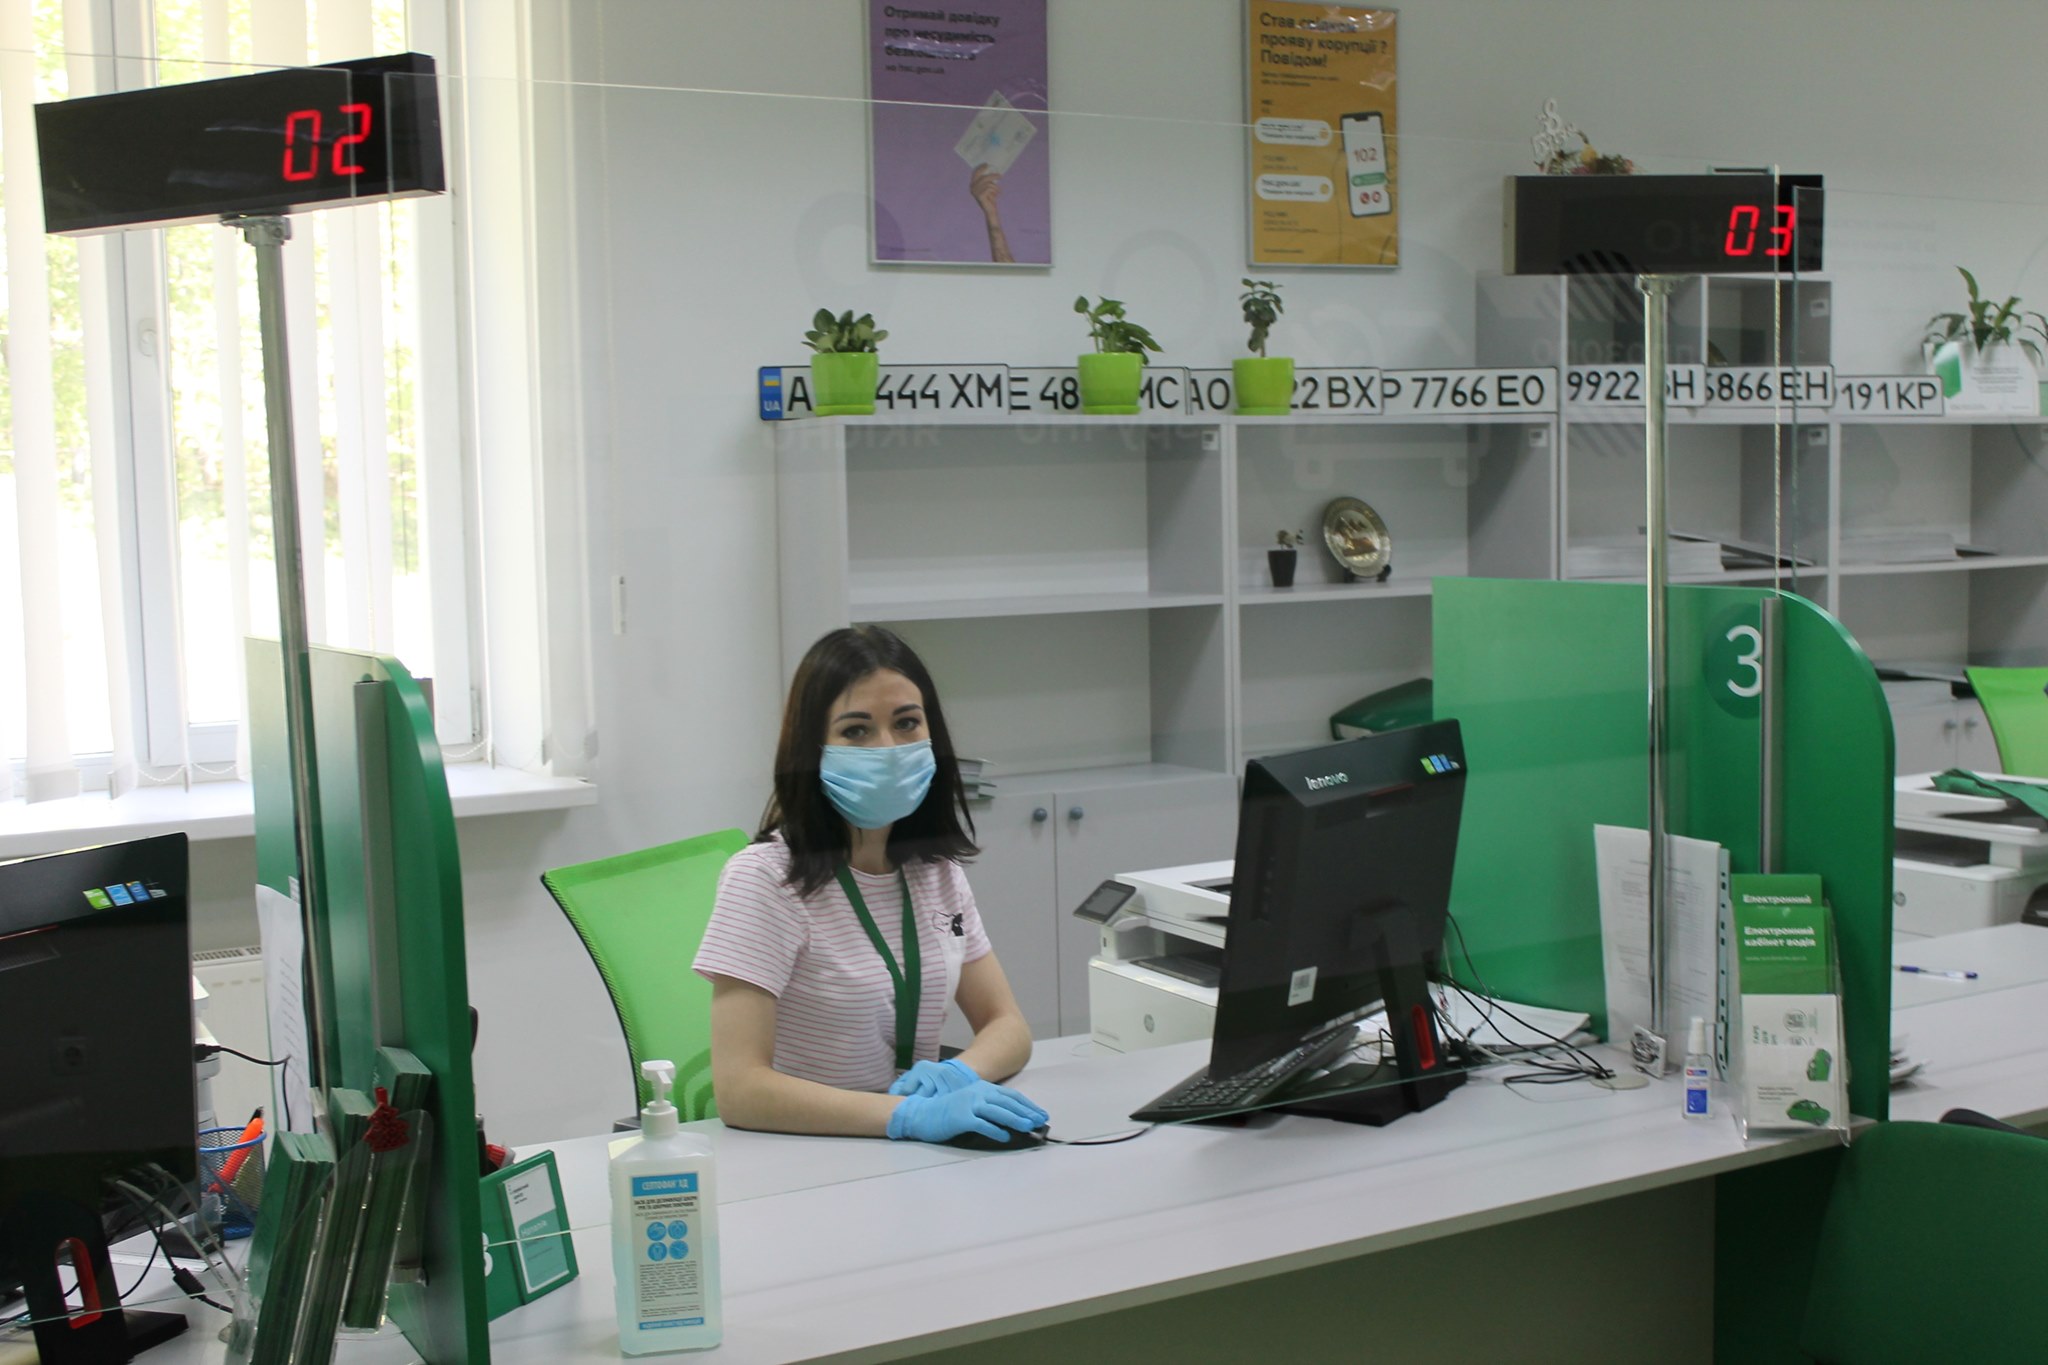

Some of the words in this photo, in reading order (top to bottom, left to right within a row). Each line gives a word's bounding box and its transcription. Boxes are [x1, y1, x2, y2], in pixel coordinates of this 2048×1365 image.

[1260, 12, 1295, 28] Став
[1260, 34, 1314, 52] прояву
[1318, 39, 1377, 55] корупції
[1260, 48, 1328, 68] Повідом!
[282, 102, 373, 181] 02
[1353, 147, 1378, 163] 102
[1724, 204, 1796, 256] 03
[1411, 375, 1488, 409] 7766
[1567, 370, 1641, 401] 9922
[1836, 382, 1889, 410] 191
[764, 401, 781, 411] UA
[1725, 624, 1763, 698] 3
[1304, 772, 1349, 790] lenovo
[1743, 926, 1816, 936] Електронний
